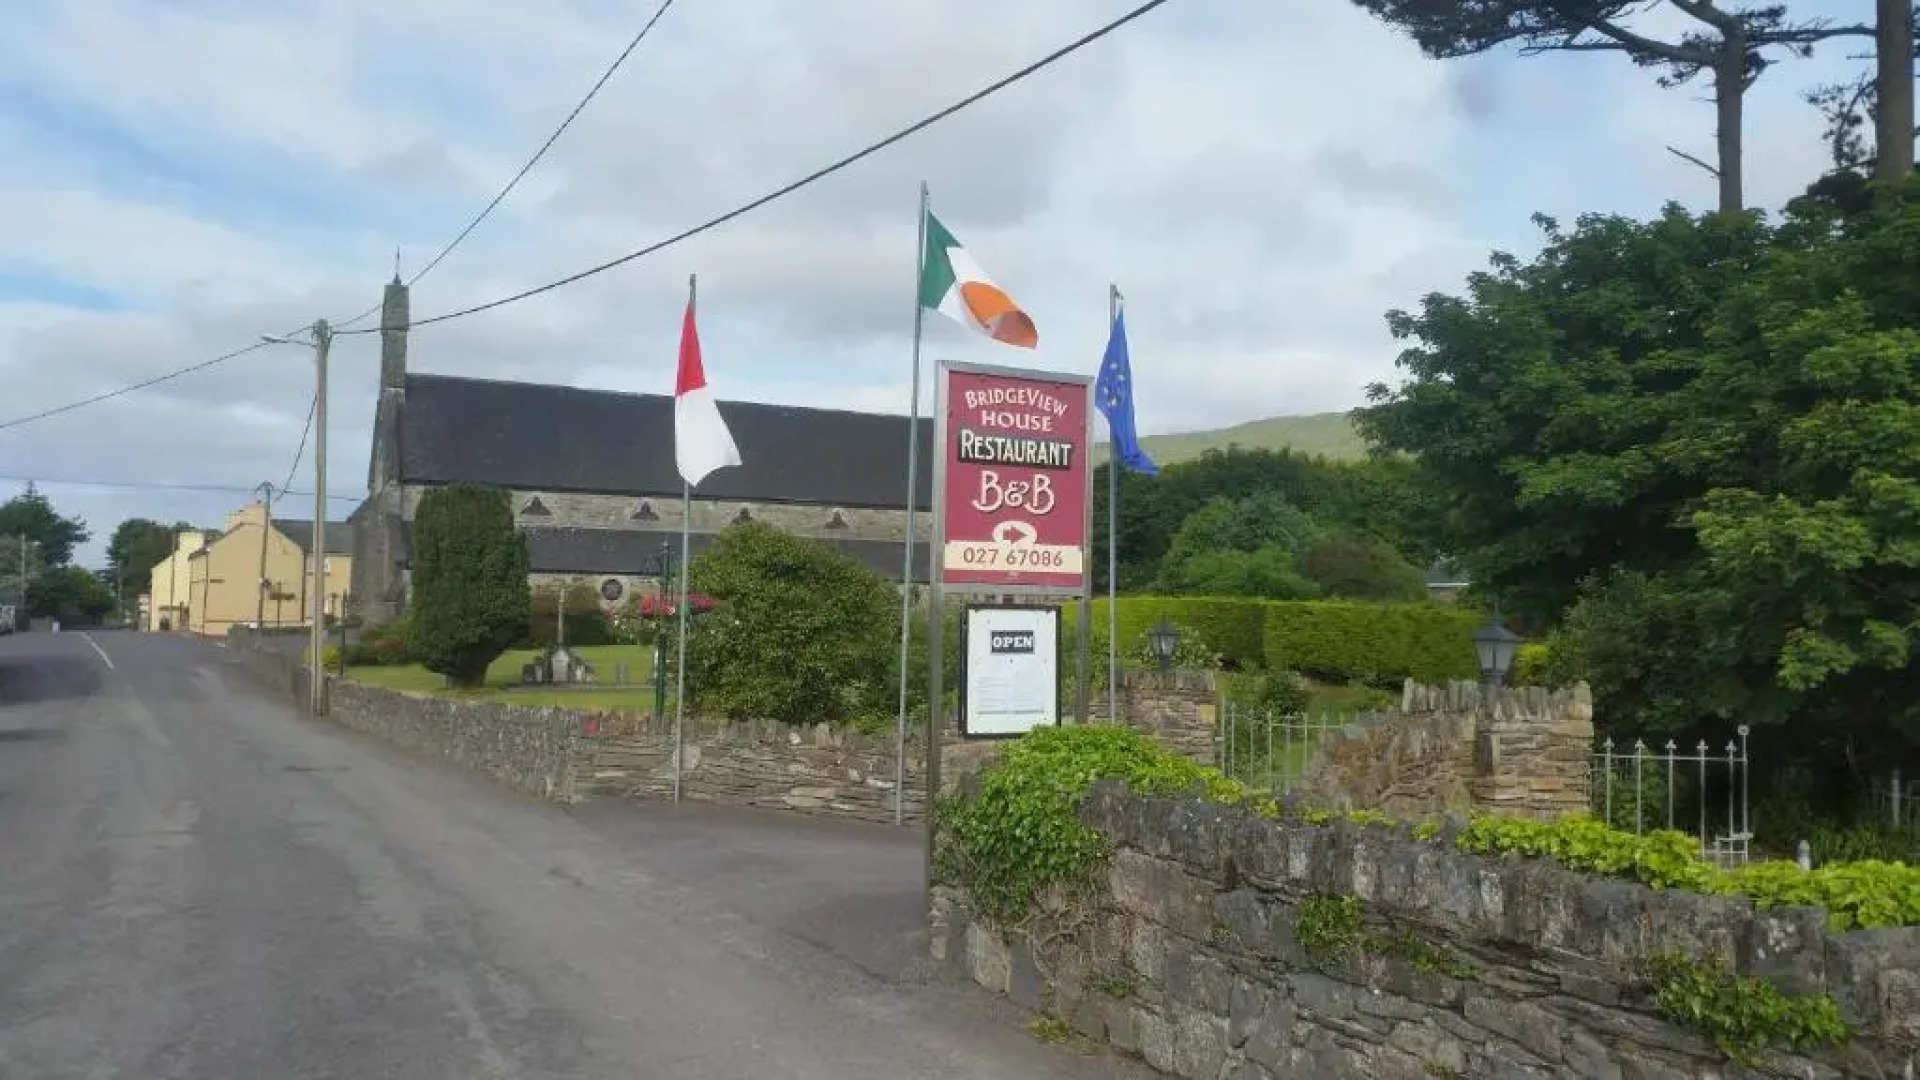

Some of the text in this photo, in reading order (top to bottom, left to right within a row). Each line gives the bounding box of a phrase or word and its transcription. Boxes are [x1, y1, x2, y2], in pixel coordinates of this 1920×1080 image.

[981, 410, 1053, 432] HOUSE
[960, 429, 1072, 466] RESTAURANT
[972, 470, 1055, 515] B&B
[963, 547, 1063, 567] 027 67086
[993, 636, 1033, 648] OPEN
